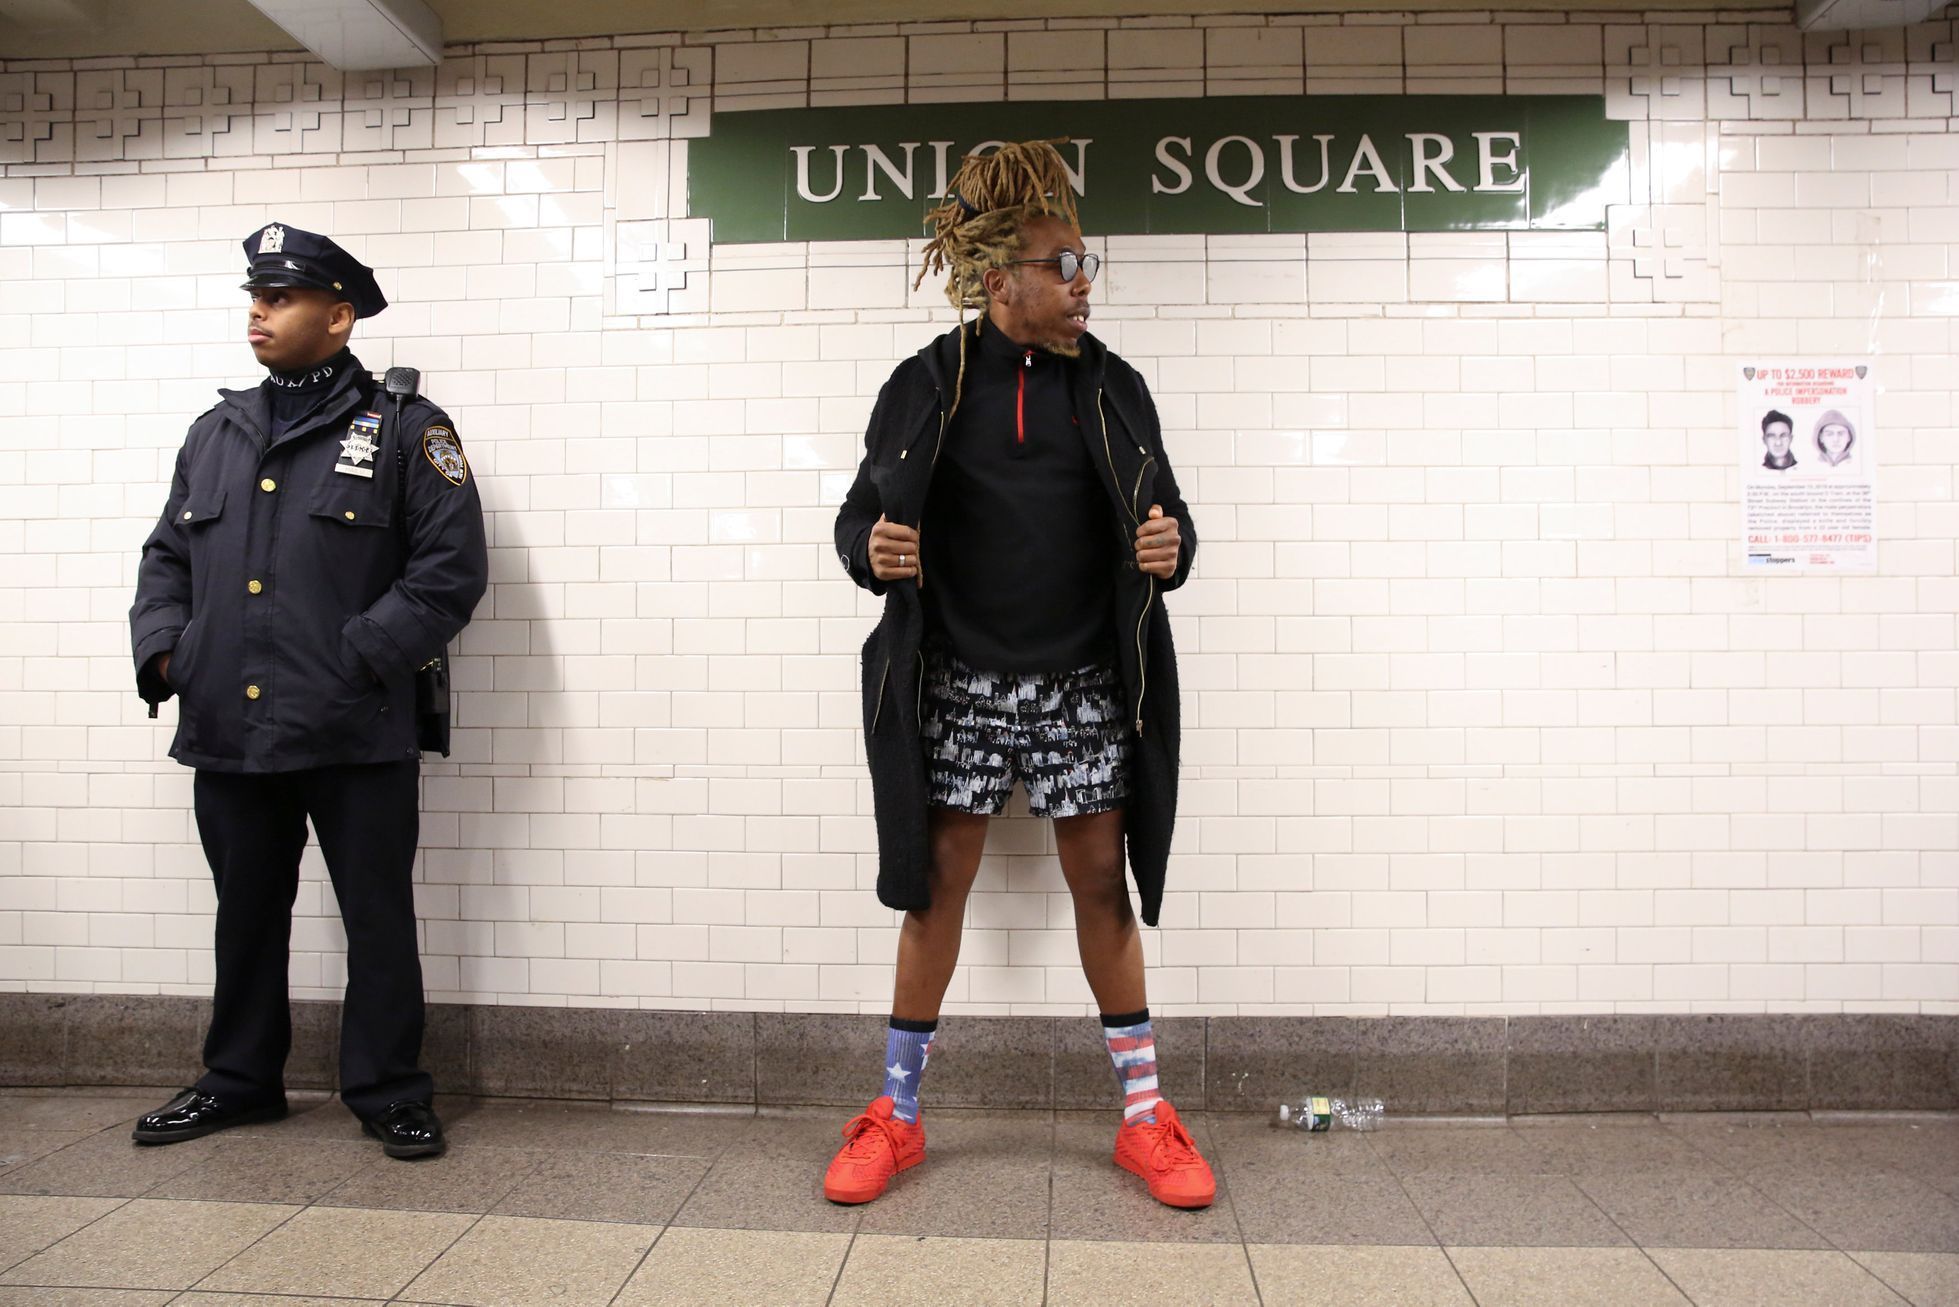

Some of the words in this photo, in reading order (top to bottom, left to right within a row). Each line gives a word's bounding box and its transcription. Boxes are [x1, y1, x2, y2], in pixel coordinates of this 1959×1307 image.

[789, 138, 1094, 203] UNIN
[1151, 131, 1527, 207] SQUARE
[1757, 369, 1768, 380] UP
[1771, 369, 1782, 380] TO
[1817, 368, 1854, 379] REWARD
[1844, 534, 1873, 545] (TIPS)
